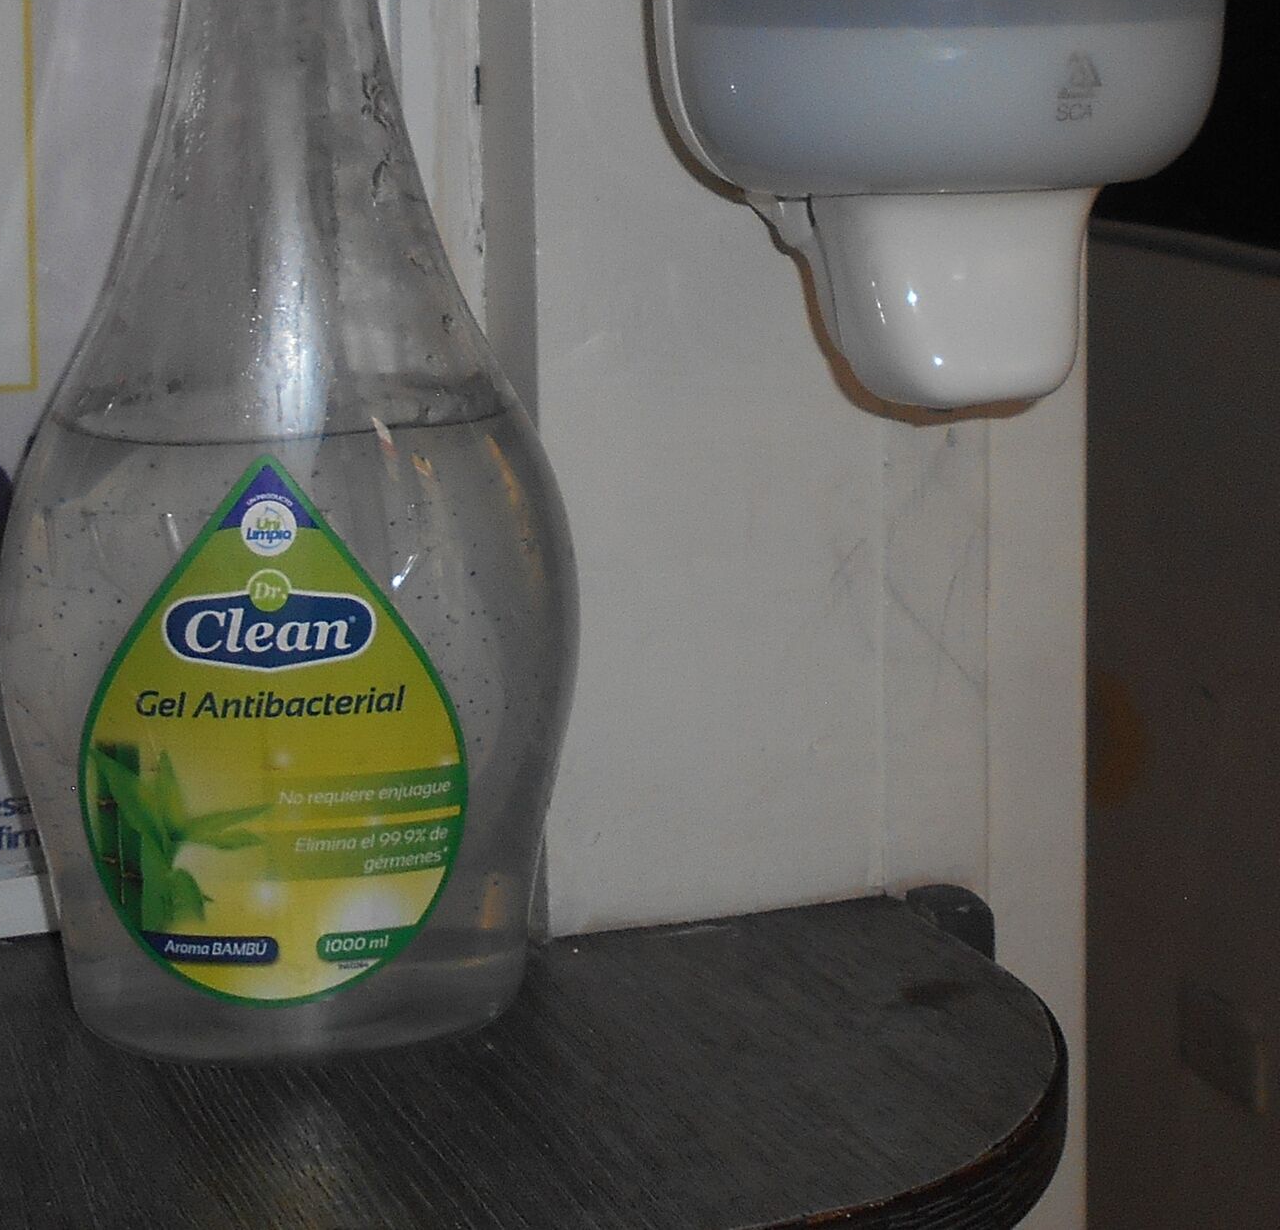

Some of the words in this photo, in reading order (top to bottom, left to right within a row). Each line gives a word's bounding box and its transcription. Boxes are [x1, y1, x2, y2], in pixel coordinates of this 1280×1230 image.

[255, 582, 287, 600] Dr.
[185, 608, 352, 653] Clean
[135, 689, 187, 719] Gel
[192, 685, 406, 719] Antibacterial
[278, 790, 304, 806] No
[307, 787, 375, 807] requiere
[378, 780, 452, 800] enjuague
[295, 837, 357, 853] Elimina
[361, 835, 375, 849] el
[429, 826, 449, 841] de
[164, 939, 210, 956] Aroma
[211, 939, 268, 957] BAMBÚ
[325, 936, 367, 953] 1000
[368, 935, 390, 950] ml
